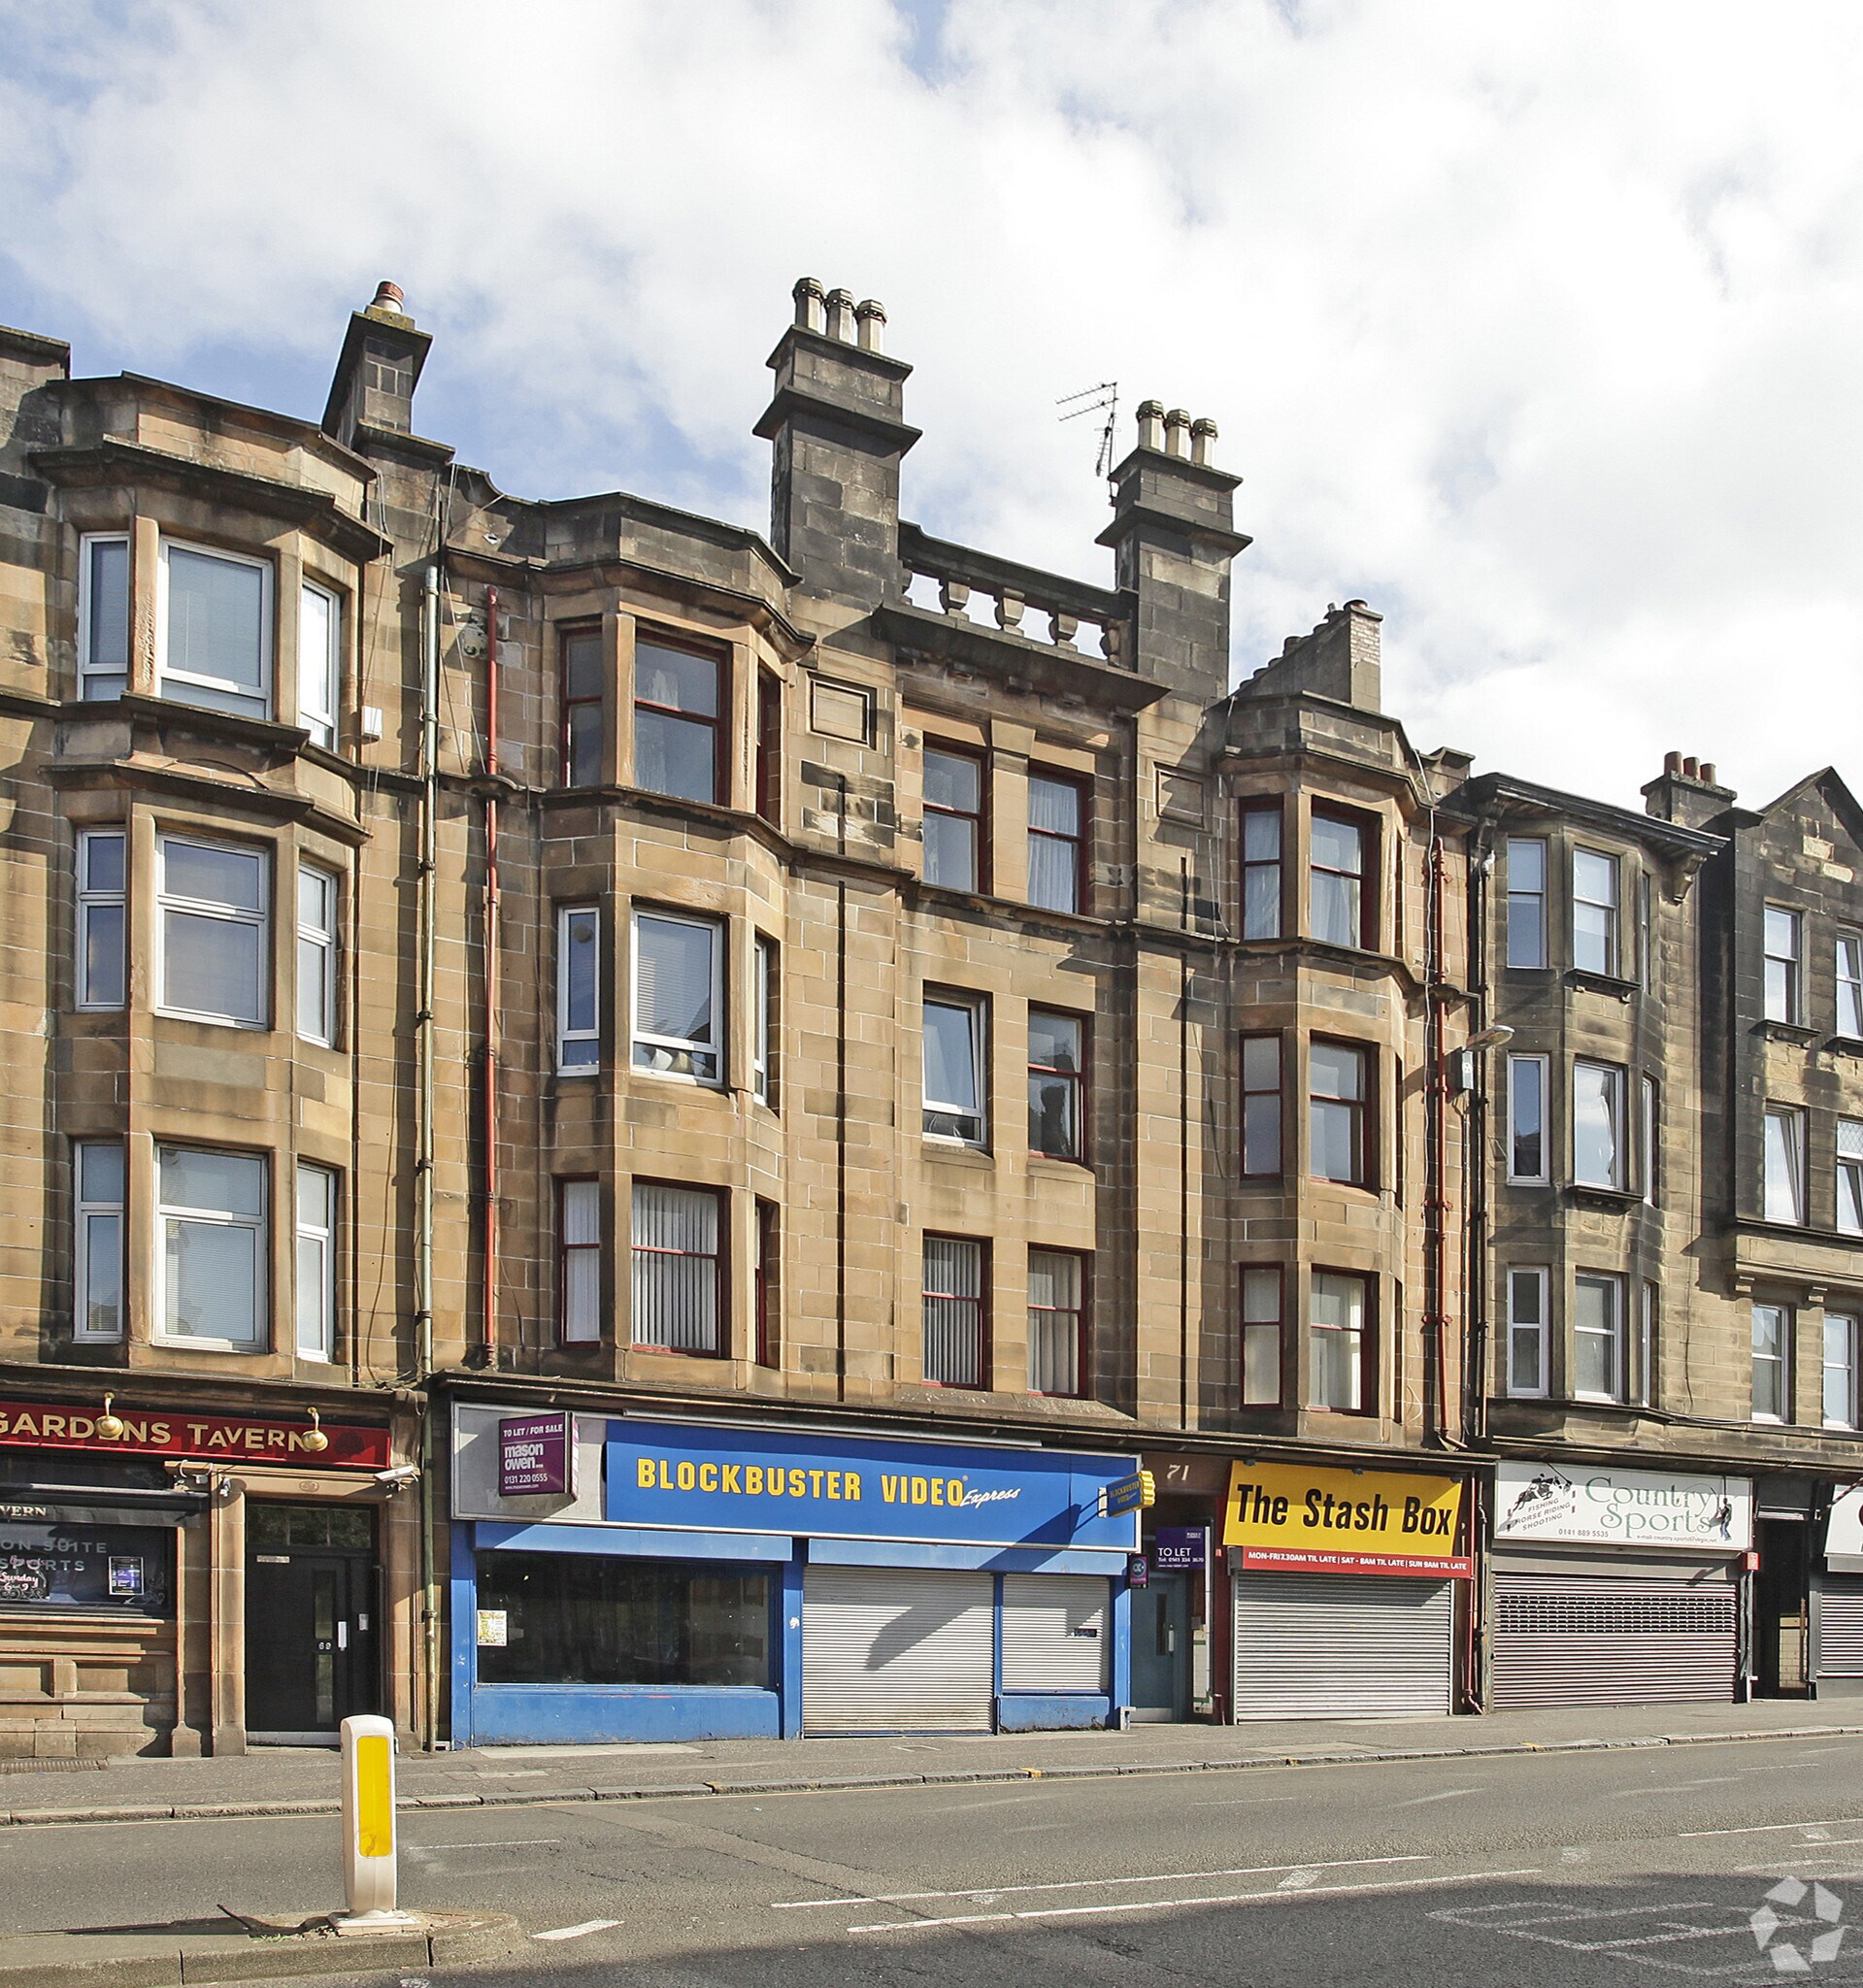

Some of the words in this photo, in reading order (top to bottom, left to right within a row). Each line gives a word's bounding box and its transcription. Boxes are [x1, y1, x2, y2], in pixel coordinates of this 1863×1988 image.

[0, 1410, 171, 1443] ARDNS
[530, 1425, 544, 1435] FOR
[545, 1424, 563, 1434] SALE
[505, 1443, 544, 1458] mason
[505, 1474, 518, 1483] 0131
[519, 1474, 531, 1483] 220
[532, 1473, 548, 1482] 0555
[1166, 1464, 1189, 1480] 71
[636, 1458, 862, 1501] BLOCKBUSTER
[880, 1474, 964, 1507] VIDEO
[960, 1488, 1021, 1508] Express
[1585, 1476, 1713, 1517] Country
[1237, 1483, 1289, 1525] The
[1302, 1488, 1389, 1531] Stash
[1401, 1496, 1452, 1536] Box
[1528, 1498, 1559, 1512] FISHING
[1545, 1502, 1570, 1515] RIDING
[1522, 1512, 1563, 1531] SHOOTING
[1600, 1502, 1713, 1538] Sports
[43, 1541, 107, 1553] SUITE
[1157, 1547, 1173, 1557] TO
[1175, 1547, 1191, 1557] LET
[0, 1557, 85, 1572] SPORTS
[1319, 1555, 1336, 1564] LATE
[318, 1641, 331, 1650] 69
